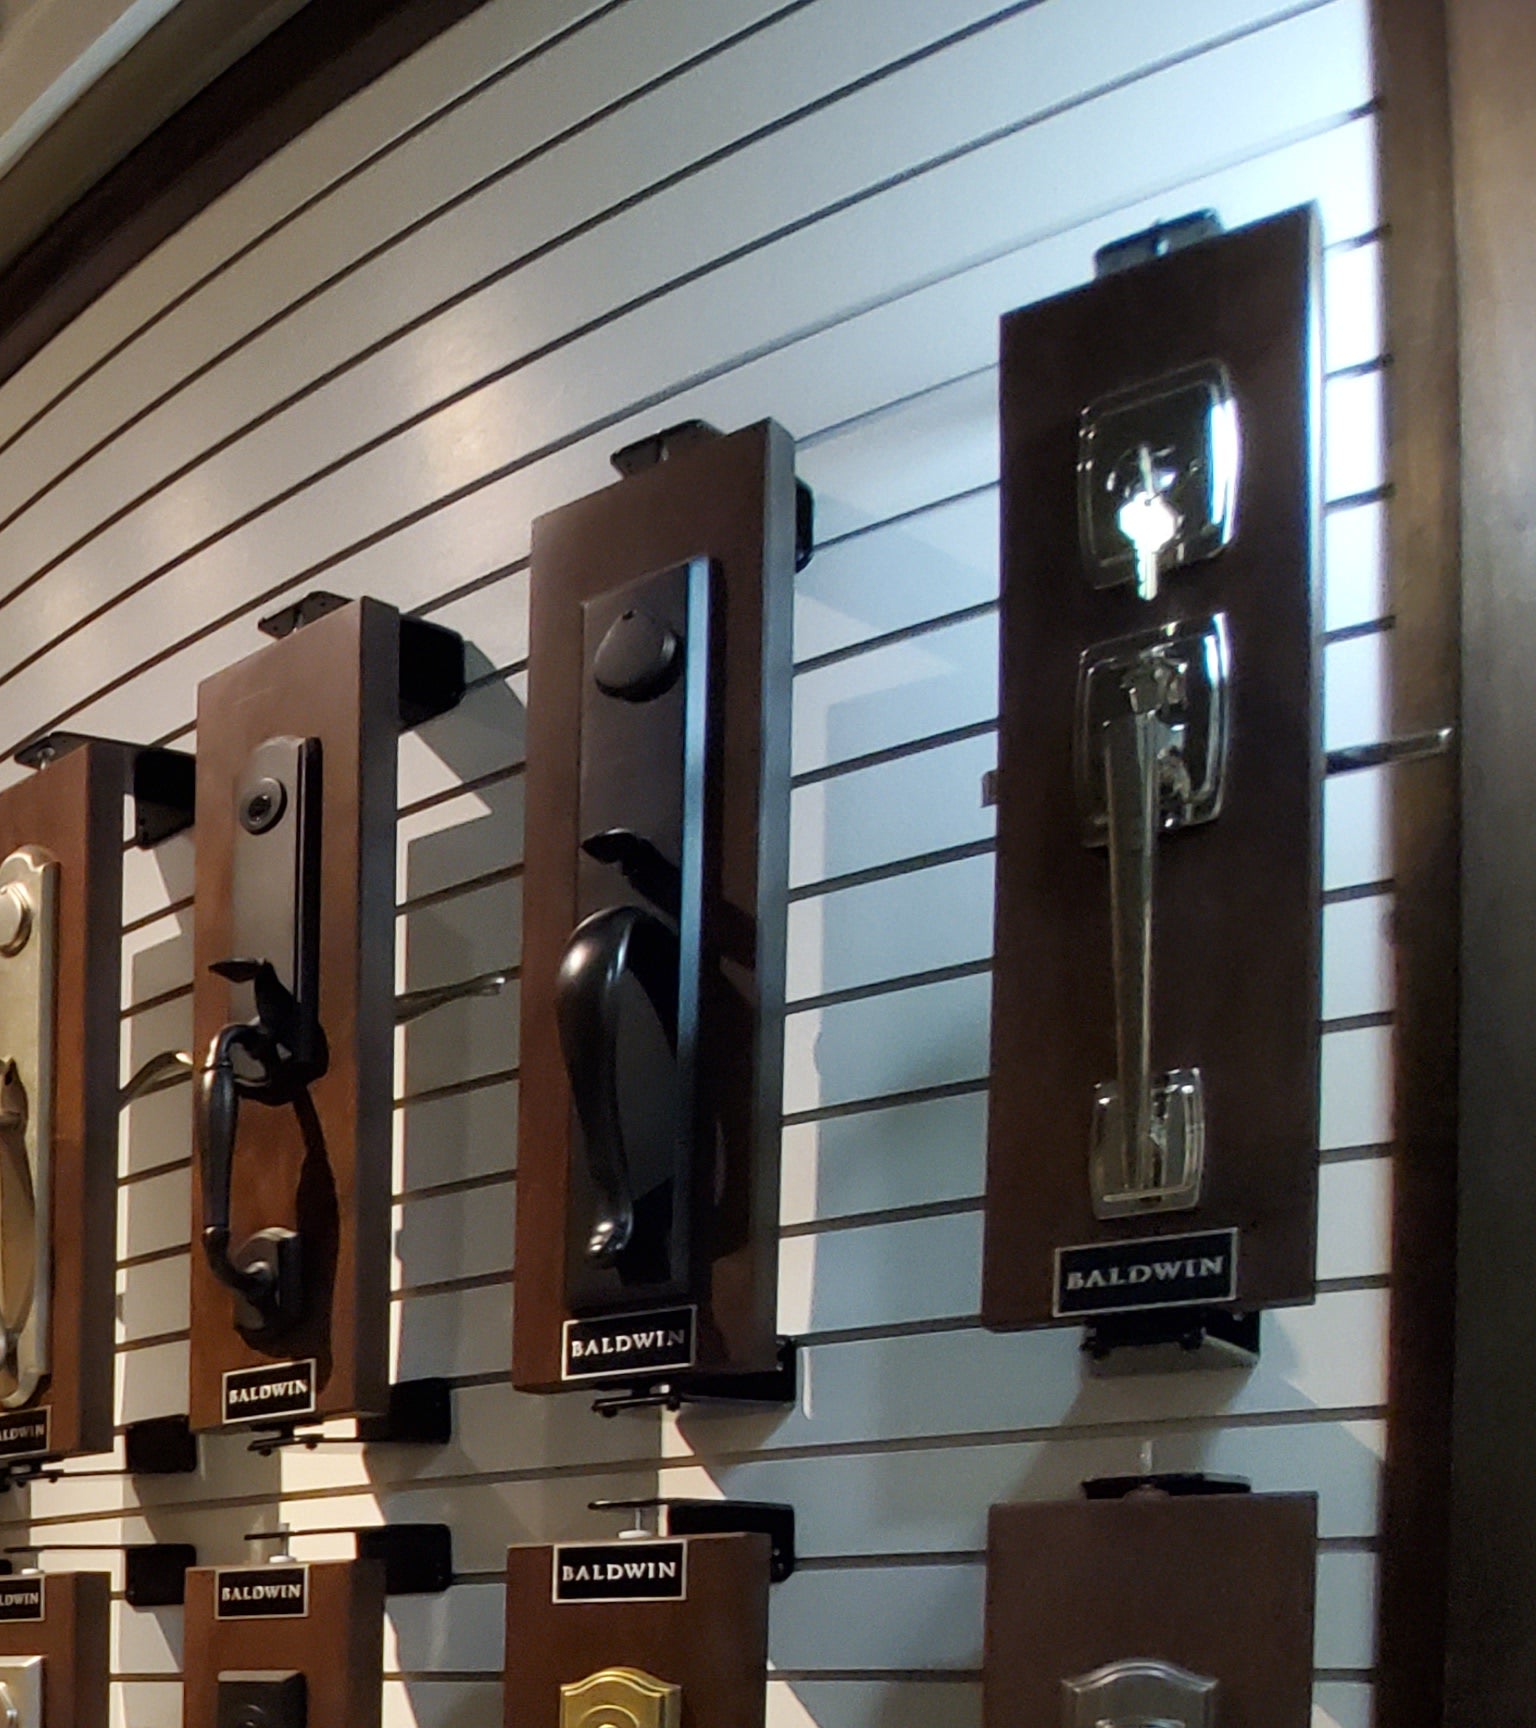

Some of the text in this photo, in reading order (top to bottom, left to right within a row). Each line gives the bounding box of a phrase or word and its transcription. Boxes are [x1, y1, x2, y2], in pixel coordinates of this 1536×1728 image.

[1066, 1256, 1225, 1291] BALDWIN
[571, 1329, 685, 1358] BALDWIN
[229, 1379, 308, 1404] BALDWIN
[562, 1562, 676, 1581] BALDWIN
[222, 1584, 302, 1601] BALDWIN
